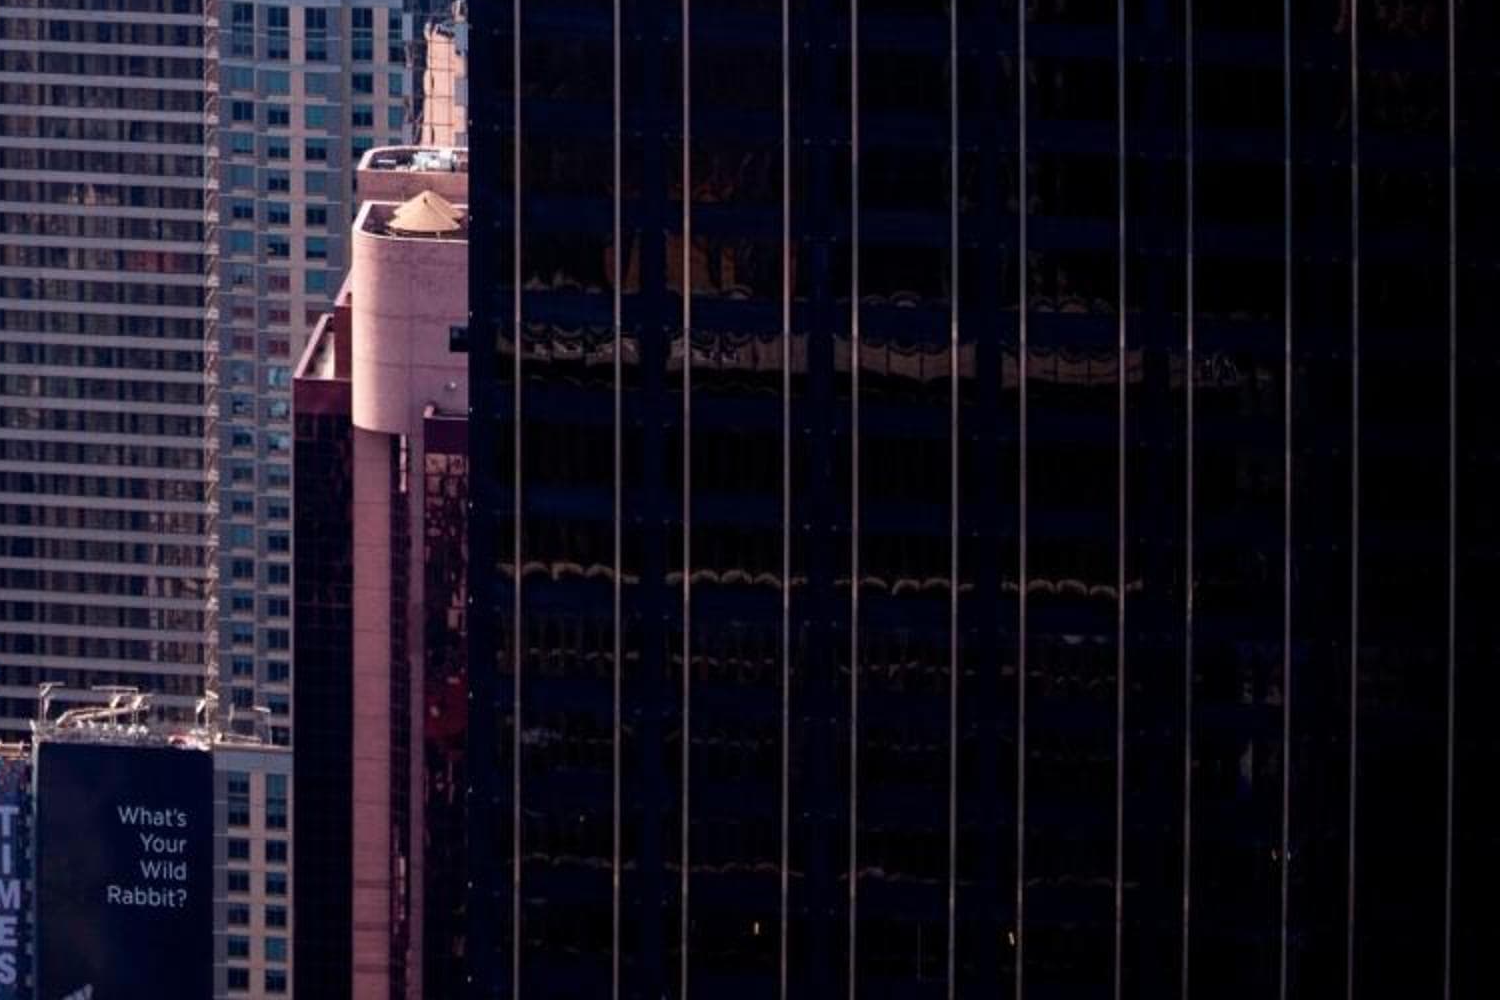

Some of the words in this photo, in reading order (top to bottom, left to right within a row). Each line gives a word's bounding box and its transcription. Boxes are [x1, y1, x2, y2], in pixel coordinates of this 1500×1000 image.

[117, 805, 188, 827] What's
[140, 832, 187, 854] Your
[140, 861, 187, 880] Wild
[106, 885, 187, 908] Rabbit?
